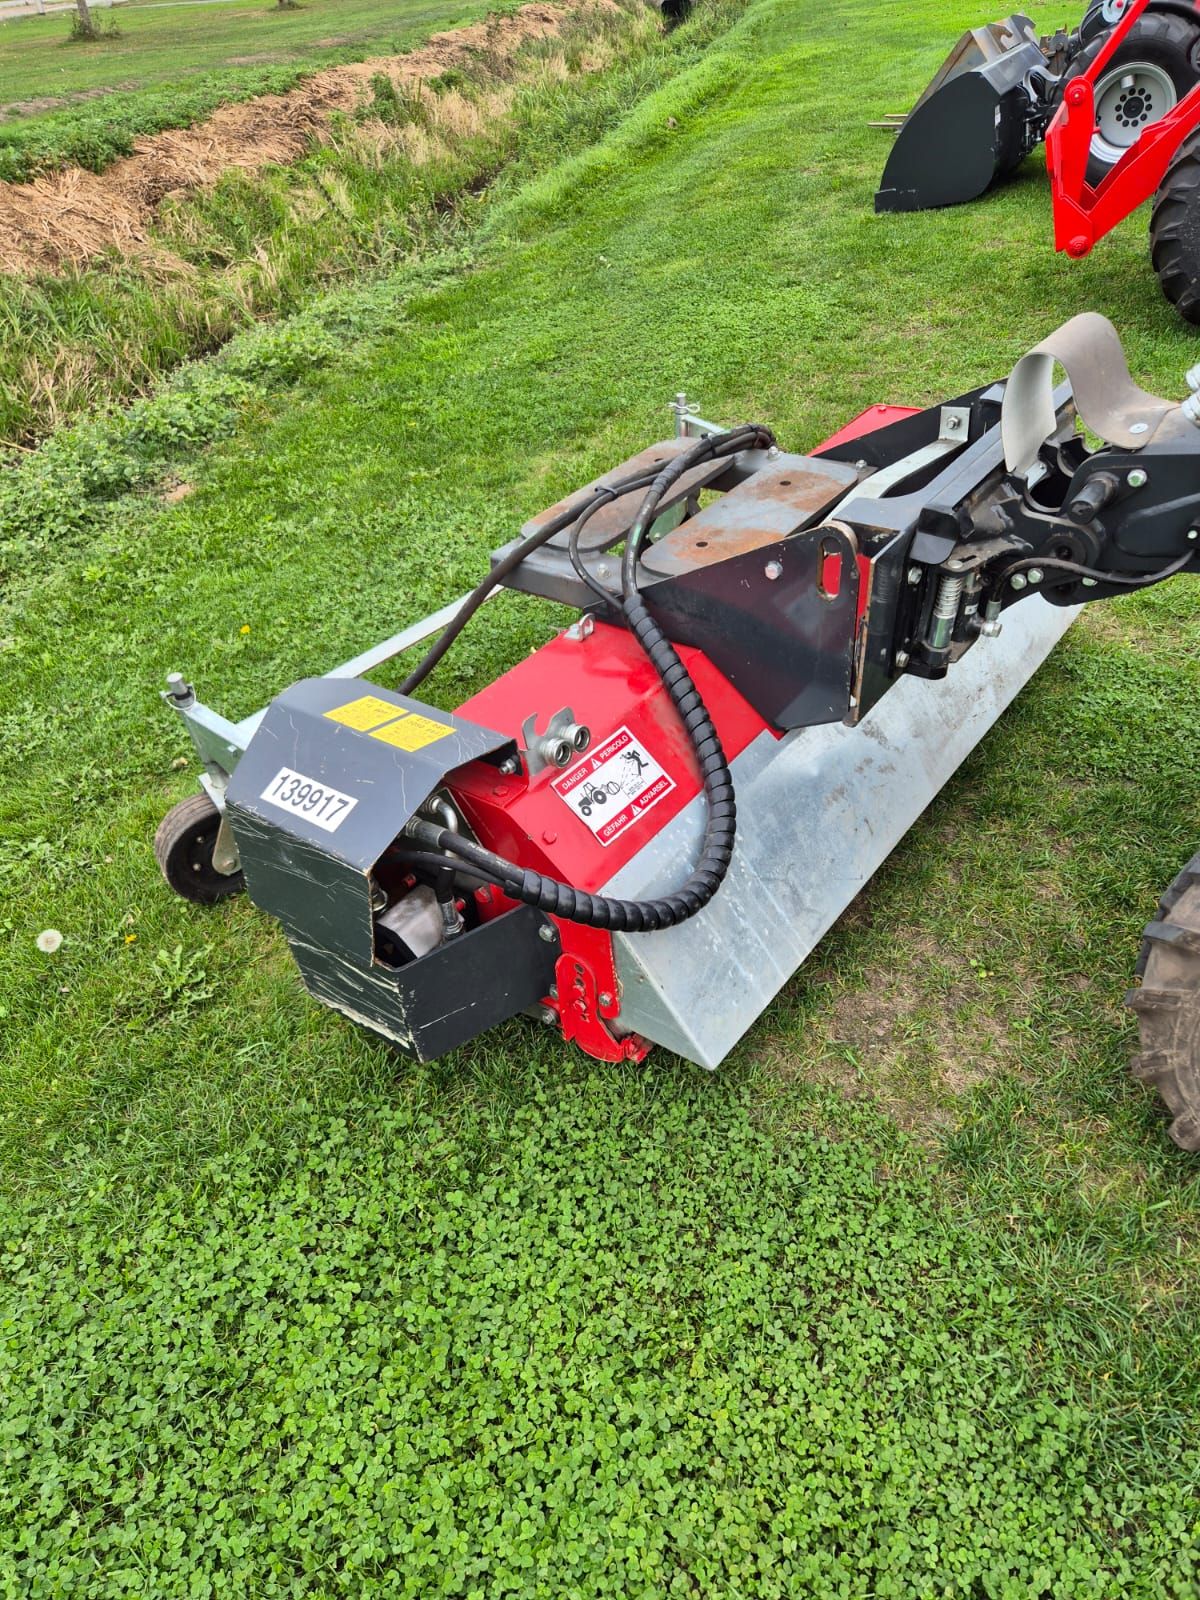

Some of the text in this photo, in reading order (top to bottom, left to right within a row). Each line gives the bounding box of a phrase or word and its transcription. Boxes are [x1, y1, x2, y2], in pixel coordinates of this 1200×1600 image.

[562, 734, 629, 791] DANGER PERICOLO
[272, 774, 350, 821] 139917
[603, 814, 628, 837] GEFAHR
[639, 780, 669, 806] ADVARSEL
